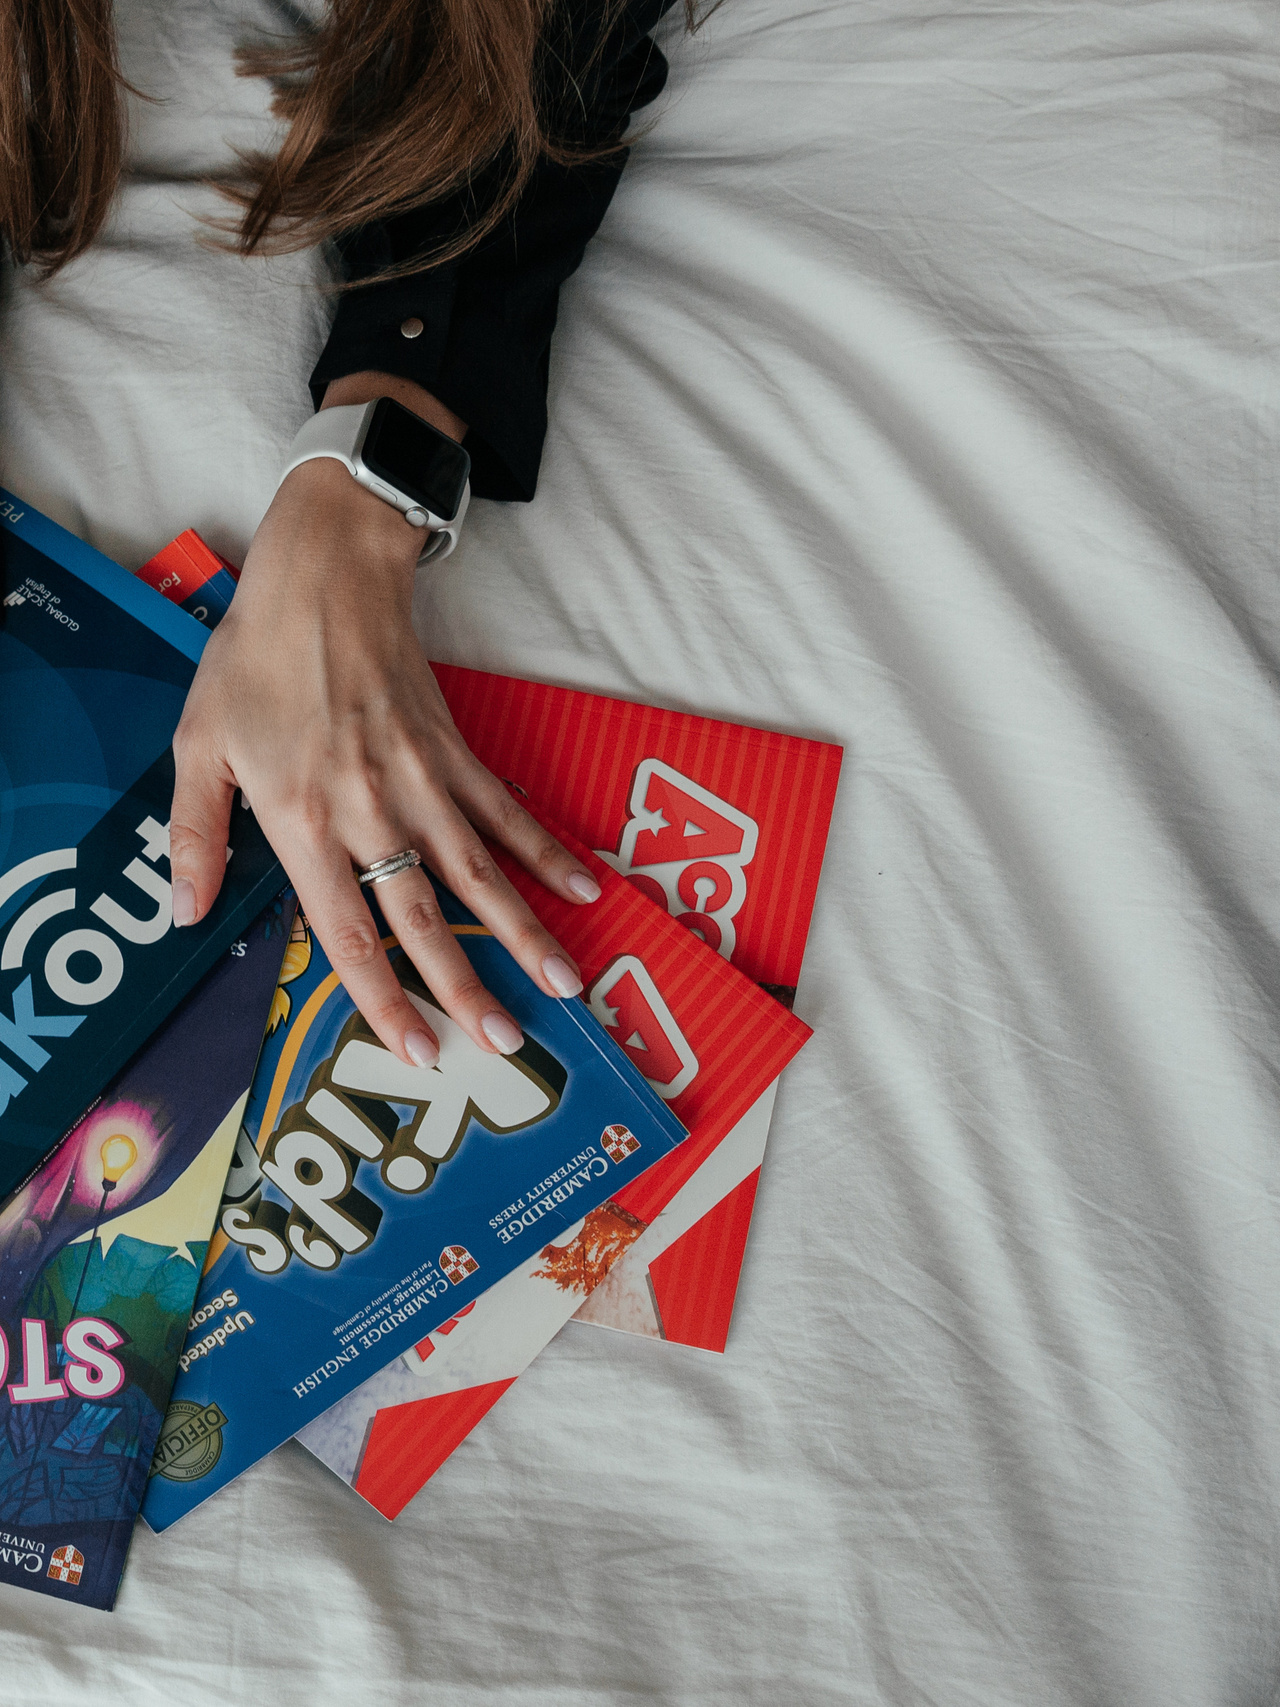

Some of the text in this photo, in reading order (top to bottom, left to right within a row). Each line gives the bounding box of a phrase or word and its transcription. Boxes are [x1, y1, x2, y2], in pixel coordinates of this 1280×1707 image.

[16, 584, 80, 632] GLOBAL SCALE
[25, 577, 61, 605] of English
[488, 1146, 597, 1229] UNIVERSITY PRESS
[497, 1156, 609, 1244] CAMBRIDGE
[188, 1289, 239, 1331] Secon
[332, 1260, 433, 1336] Part of the University of Cambridge
[358, 1279, 449, 1349] CAMBRIDGE
[394, 1269, 441, 1306] Language
[179, 1311, 255, 1373] Updated
[339, 1303, 392, 1346] Assessment
[292, 1344, 360, 1399] ENGLISH
